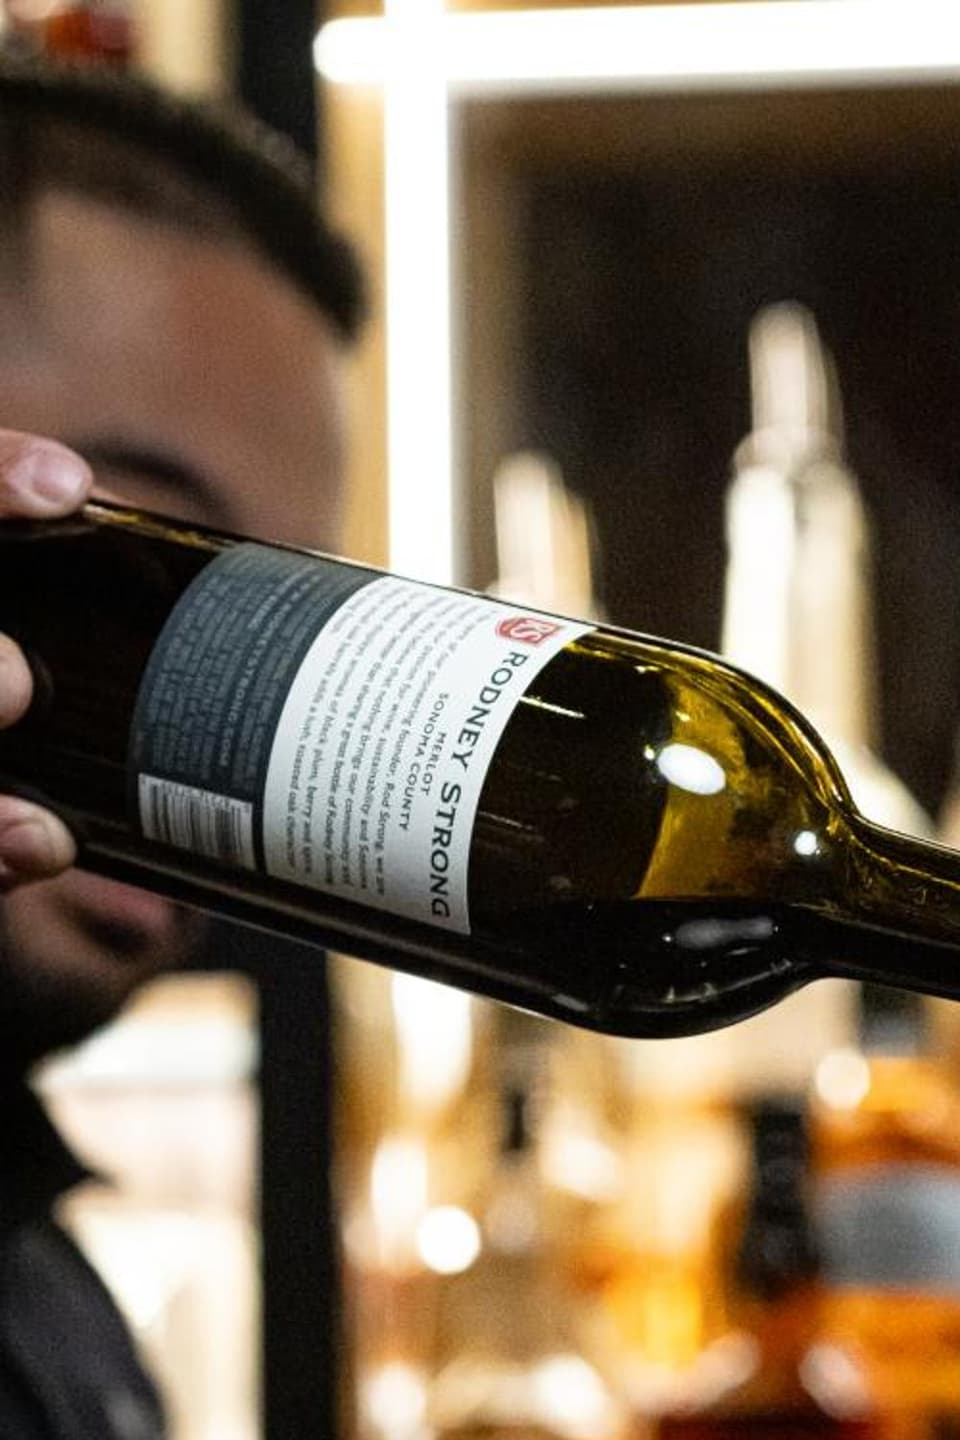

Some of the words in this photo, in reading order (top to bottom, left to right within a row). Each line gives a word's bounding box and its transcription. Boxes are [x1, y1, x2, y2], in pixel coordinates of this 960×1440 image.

[400, 668, 439, 727] pioneering
[414, 693, 448, 757] SONOMA
[450, 651, 529, 772] RODNEY
[315, 714, 336, 747] black
[359, 735, 389, 815] sustainability
[380, 780, 396, 809] Rod
[419, 731, 447, 796] MERLOT
[301, 783, 318, 820] berry
[397, 761, 421, 832] COUNTY
[429, 781, 461, 923] STRONG
